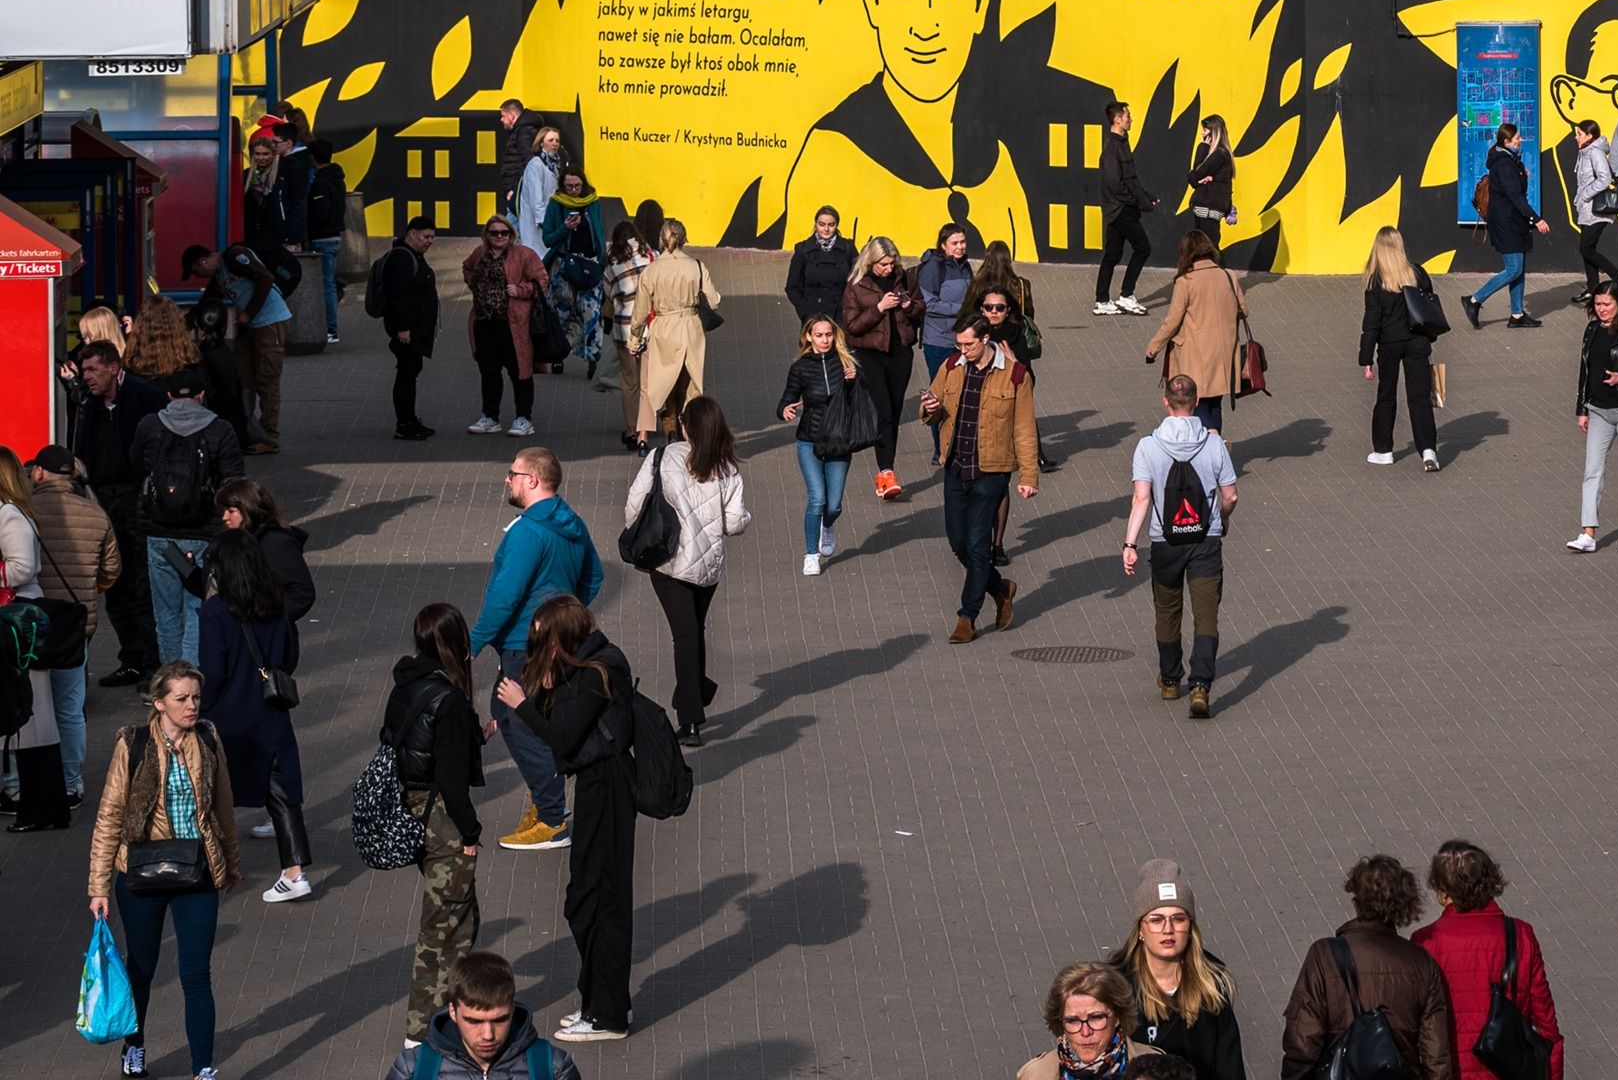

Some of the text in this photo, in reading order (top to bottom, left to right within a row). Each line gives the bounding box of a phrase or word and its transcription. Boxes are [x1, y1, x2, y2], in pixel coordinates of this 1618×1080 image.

[639, 7, 648, 15] w
[653, 0, 696, 20] jakimś
[701, 0, 751, 23] letargu,
[599, 26, 808, 51] nawet się nie bałam. Ocalałam,
[97, 60, 179, 73] 8513309
[599, 50, 798, 77] bo zawsze był ktoś obok mnie,
[599, 75, 727, 98] kto mnie prowadził.
[600, 126, 786, 148] Hena Kuczer / Krystyna Budnicka
[16, 263, 56, 274] Tickets
[1172, 523, 1203, 534] Reebok
